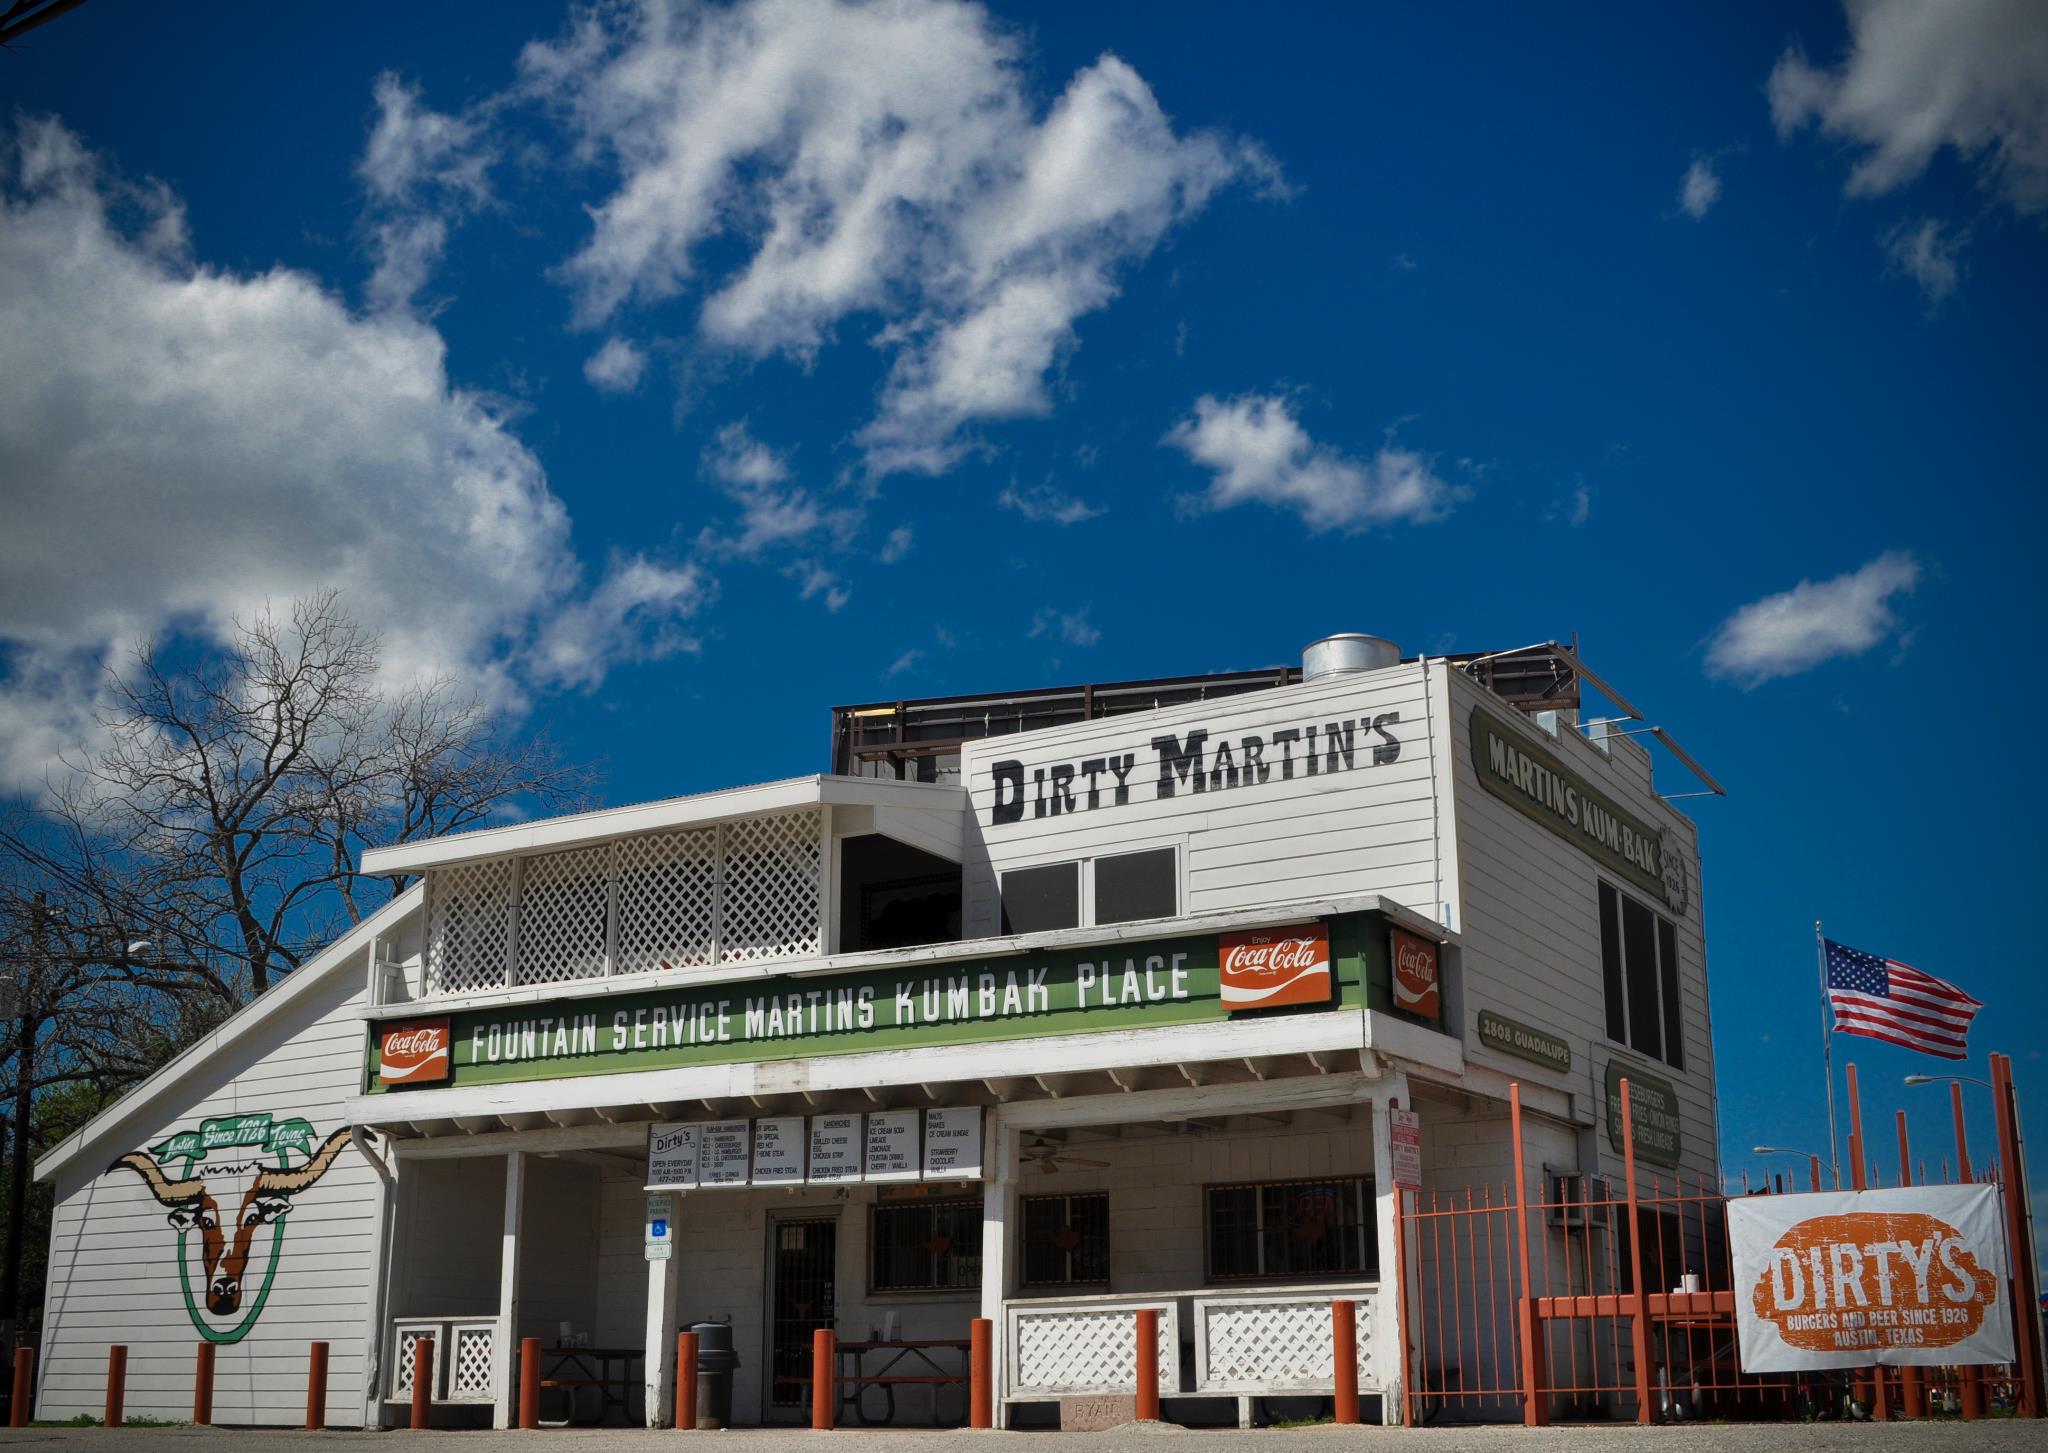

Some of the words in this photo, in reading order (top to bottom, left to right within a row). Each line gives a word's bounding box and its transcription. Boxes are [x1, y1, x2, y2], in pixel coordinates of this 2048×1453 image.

[992, 753, 1135, 826] DIRTY
[1151, 711, 1400, 800] MARTIN'S
[1252, 936, 1271, 944] Enjoy
[1225, 936, 1318, 975] Coca-Cola
[1398, 944, 1432, 982] Coca-Cola
[472, 1014, 597, 1063] FOUNTAIN
[613, 1001, 731, 1050] SERVICE
[745, 985, 875, 1039] MARTINS
[896, 967, 1049, 1025] KUMBAK
[1077, 952, 1188, 1008] PLACE
[385, 1028, 442, 1057] Coca-Cola
[1484, 1019, 1511, 1043] 2808
[1515, 1031, 1569, 1064] GUADALUPE
[928, 1121, 945, 1129] SHAKES
[929, 1112, 943, 1120] MALTS
[203, 1123, 235, 1147] Since
[270, 1124, 305, 1149] Texas
[878, 1127, 892, 1135] CREAM
[893, 1126, 904, 1134] SODA
[937, 1130, 951, 1138] CREAM
[953, 1129, 969, 1137] SUNDAE
[165, 1137, 196, 1159] Austin
[657, 1130, 690, 1151] Dirty's
[813, 1137, 830, 1145] GRILLED
[812, 1152, 831, 1160] CHICKEN
[930, 1147, 959, 1156] STRAWBERRY
[930, 1156, 956, 1165] CHOCOLATE
[652, 1160, 666, 1168] OPEN
[668, 1159, 693, 1167] EVERYDAY
[870, 1162, 886, 1170] CHERRY
[892, 1161, 908, 1169] VANILLA
[1771, 1231, 1975, 1310] DIRTY'S
[1787, 1311, 1838, 1331] BURGERS
[1842, 1311, 1865, 1328] AND
[1869, 1310, 1898, 1327] BEER
[1902, 1308, 1937, 1325] SINCE
[1942, 1307, 1969, 1324] 1926
[1887, 1328, 1925, 1344] TEXAS
